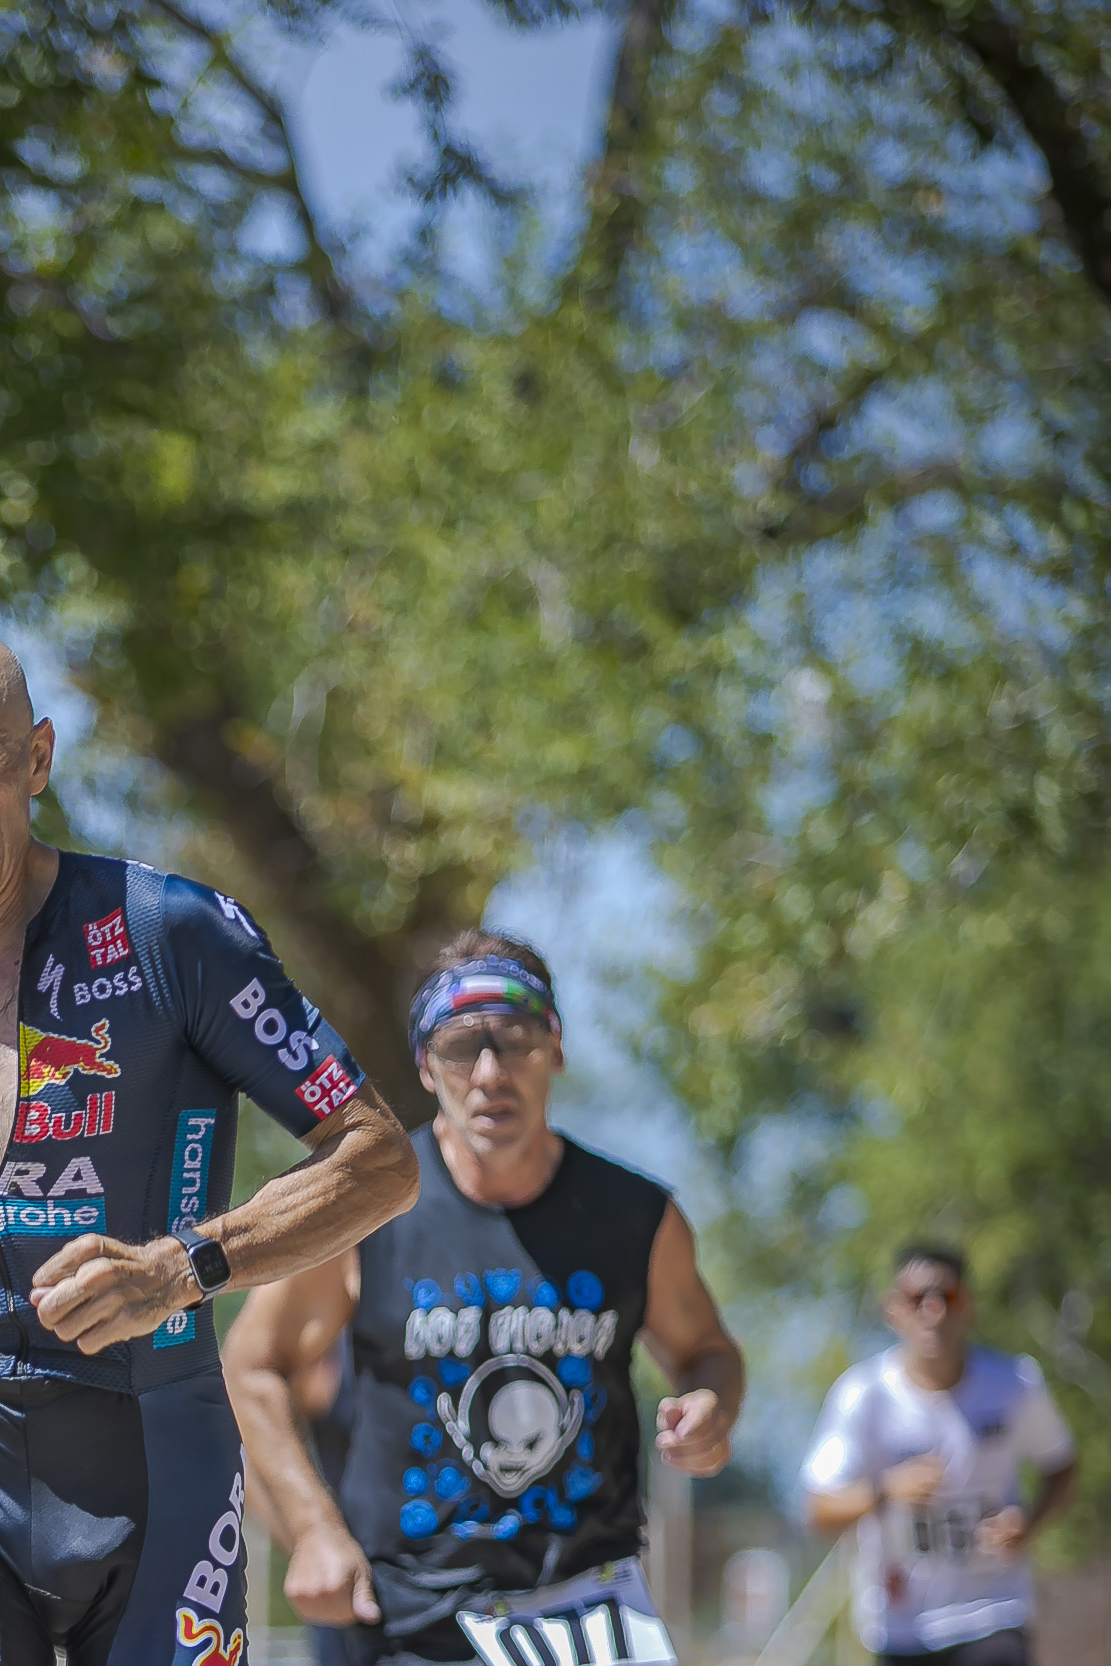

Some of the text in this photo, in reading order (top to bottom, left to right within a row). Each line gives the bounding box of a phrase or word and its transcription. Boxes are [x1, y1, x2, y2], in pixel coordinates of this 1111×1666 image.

[87, 915, 124, 946] ÖTZ
[90, 939, 129, 965] TAL
[72, 966, 142, 1005] BOSS
[300, 1062, 344, 1103] ÖTZ
[13, 1091, 116, 1144] Bull
